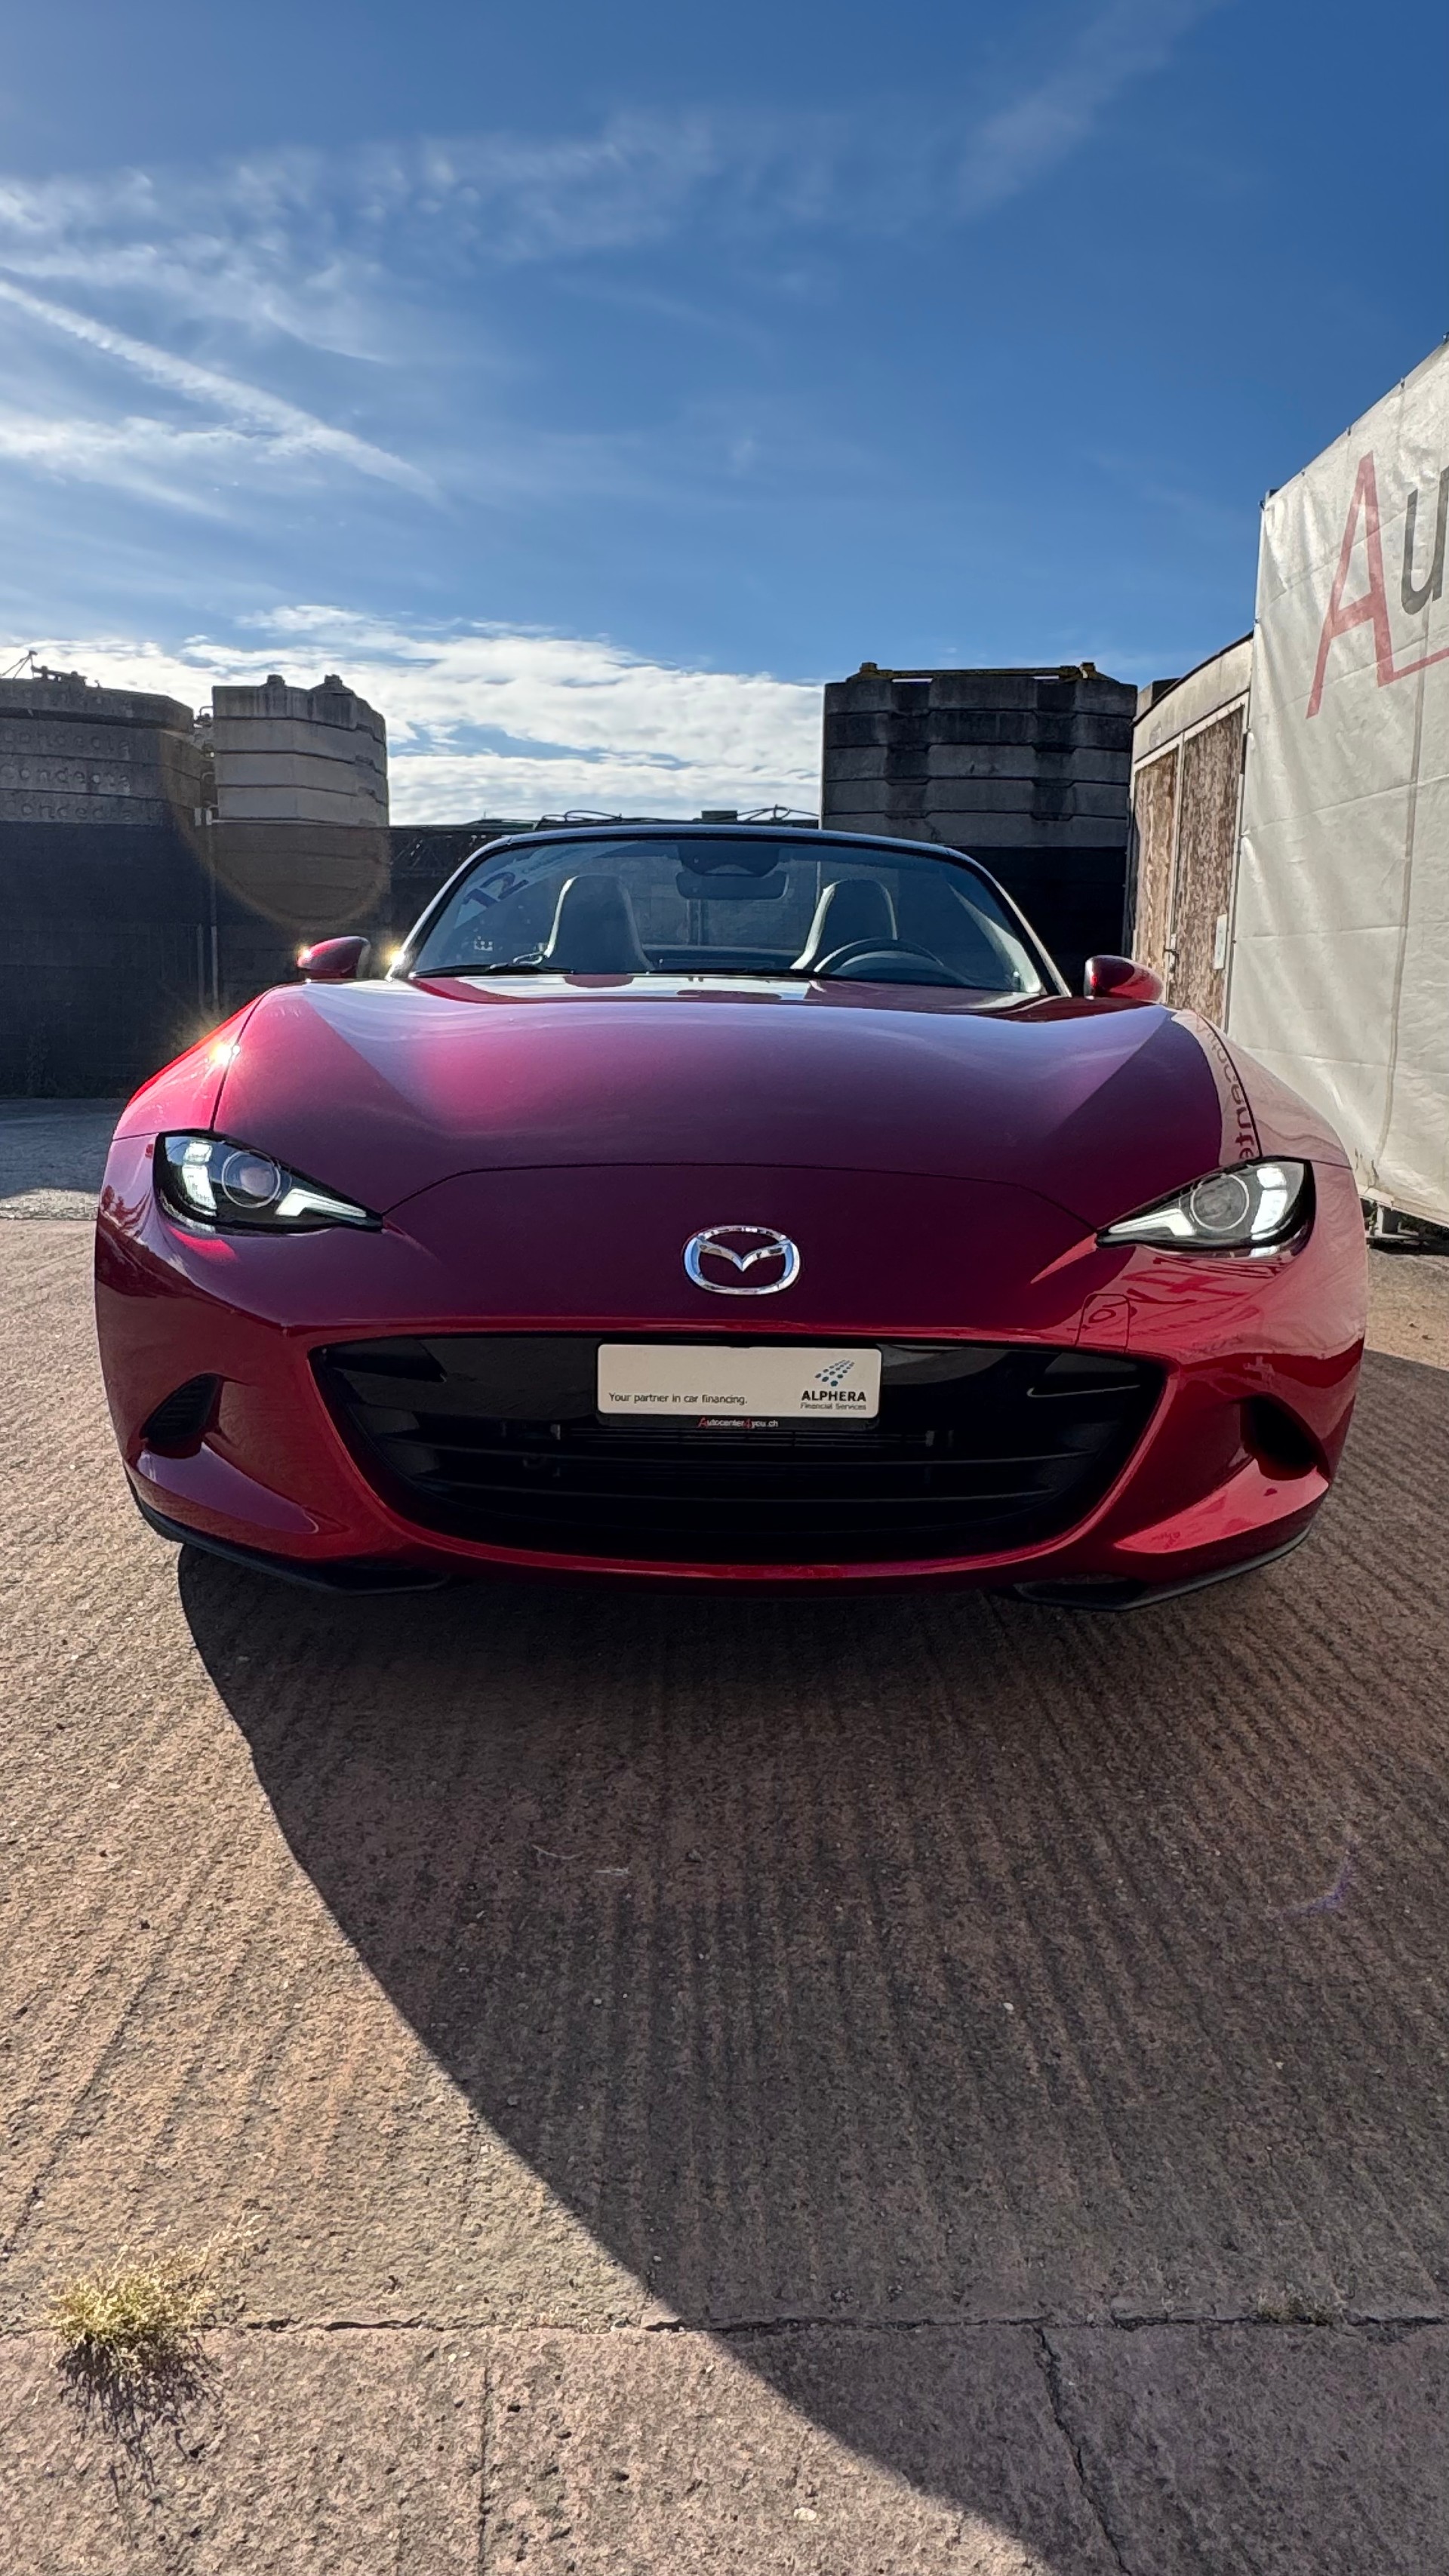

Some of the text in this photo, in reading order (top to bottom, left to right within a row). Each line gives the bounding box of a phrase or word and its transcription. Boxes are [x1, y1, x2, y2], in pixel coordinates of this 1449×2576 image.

[608, 1392, 748, 1405] Your partner in car financing.
[801, 1390, 867, 1402] ALPHERA
